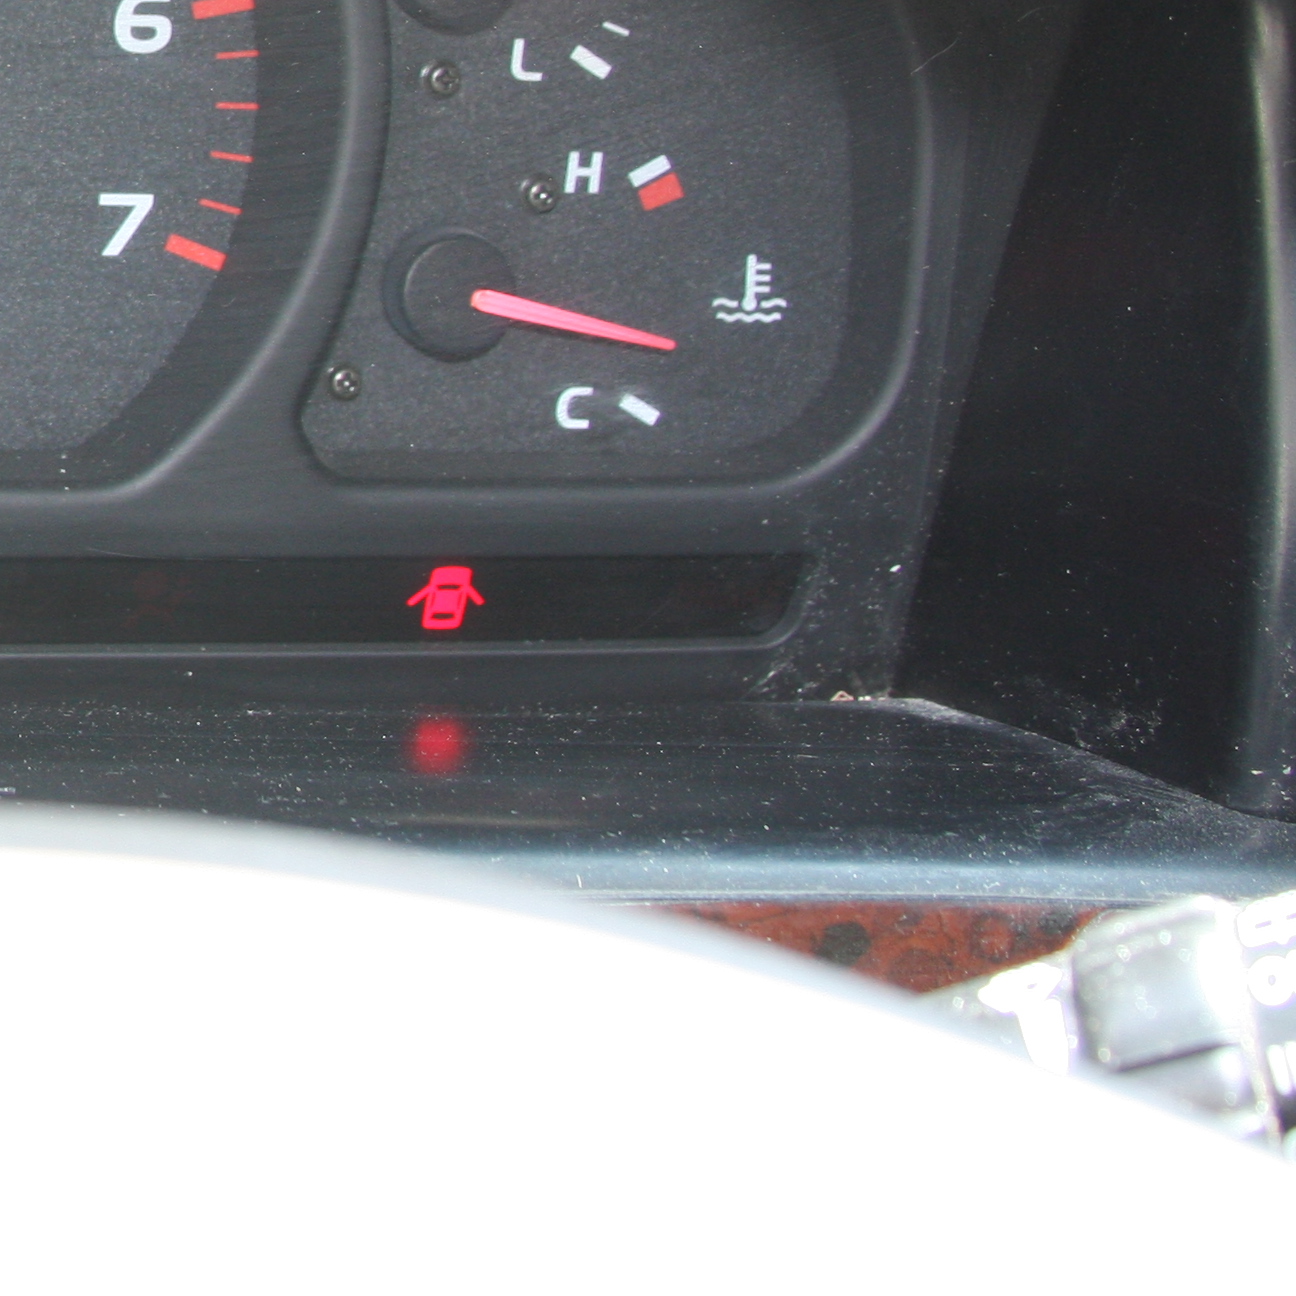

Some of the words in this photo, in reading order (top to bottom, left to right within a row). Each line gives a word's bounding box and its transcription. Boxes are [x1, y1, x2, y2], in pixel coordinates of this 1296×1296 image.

[511, 39, 543, 81] L
[565, 152, 603, 193] H
[99, 193, 154, 256] 7
[556, 387, 593, 429] C
